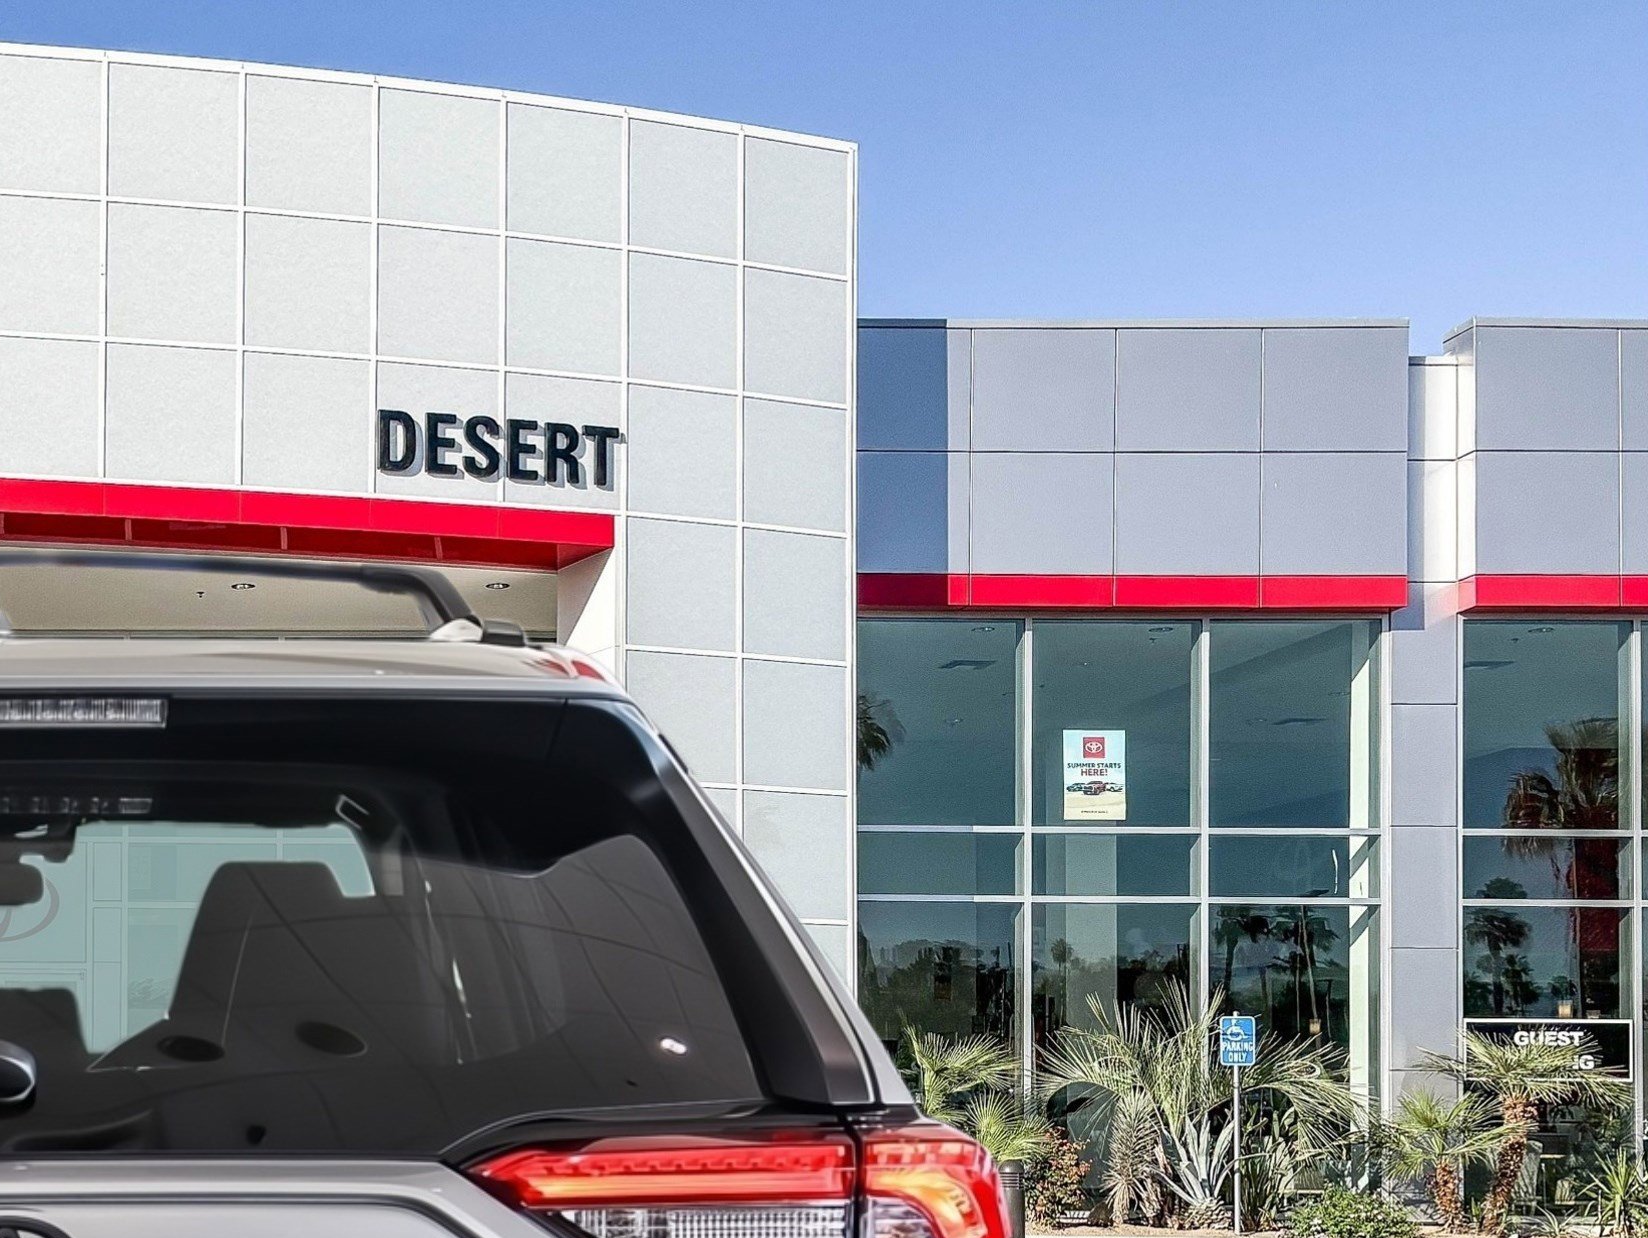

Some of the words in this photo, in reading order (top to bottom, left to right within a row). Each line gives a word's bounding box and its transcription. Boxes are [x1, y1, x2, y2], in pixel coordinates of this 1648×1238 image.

[377, 408, 621, 487] DESERT
[1513, 1030, 1584, 1047] GUEST
[1222, 1041, 1253, 1052] PARKING
[1228, 1052, 1247, 1062] ONLY
